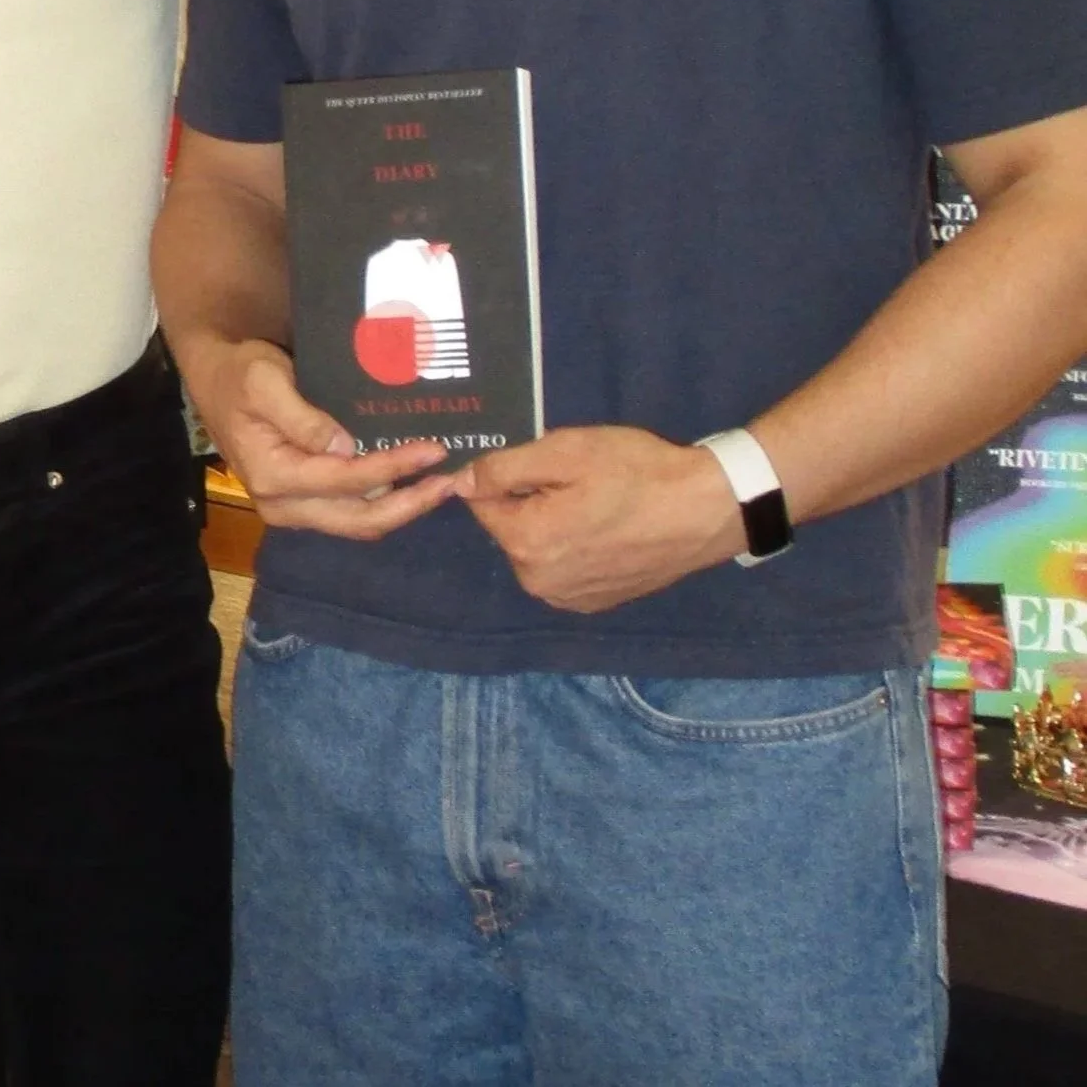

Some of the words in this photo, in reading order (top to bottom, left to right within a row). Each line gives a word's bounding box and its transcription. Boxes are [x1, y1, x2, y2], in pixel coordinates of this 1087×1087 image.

[383, 122, 429, 141] THE
[373, 161, 439, 184] DIARY
[354, 394, 484, 415] SUGARBABY
